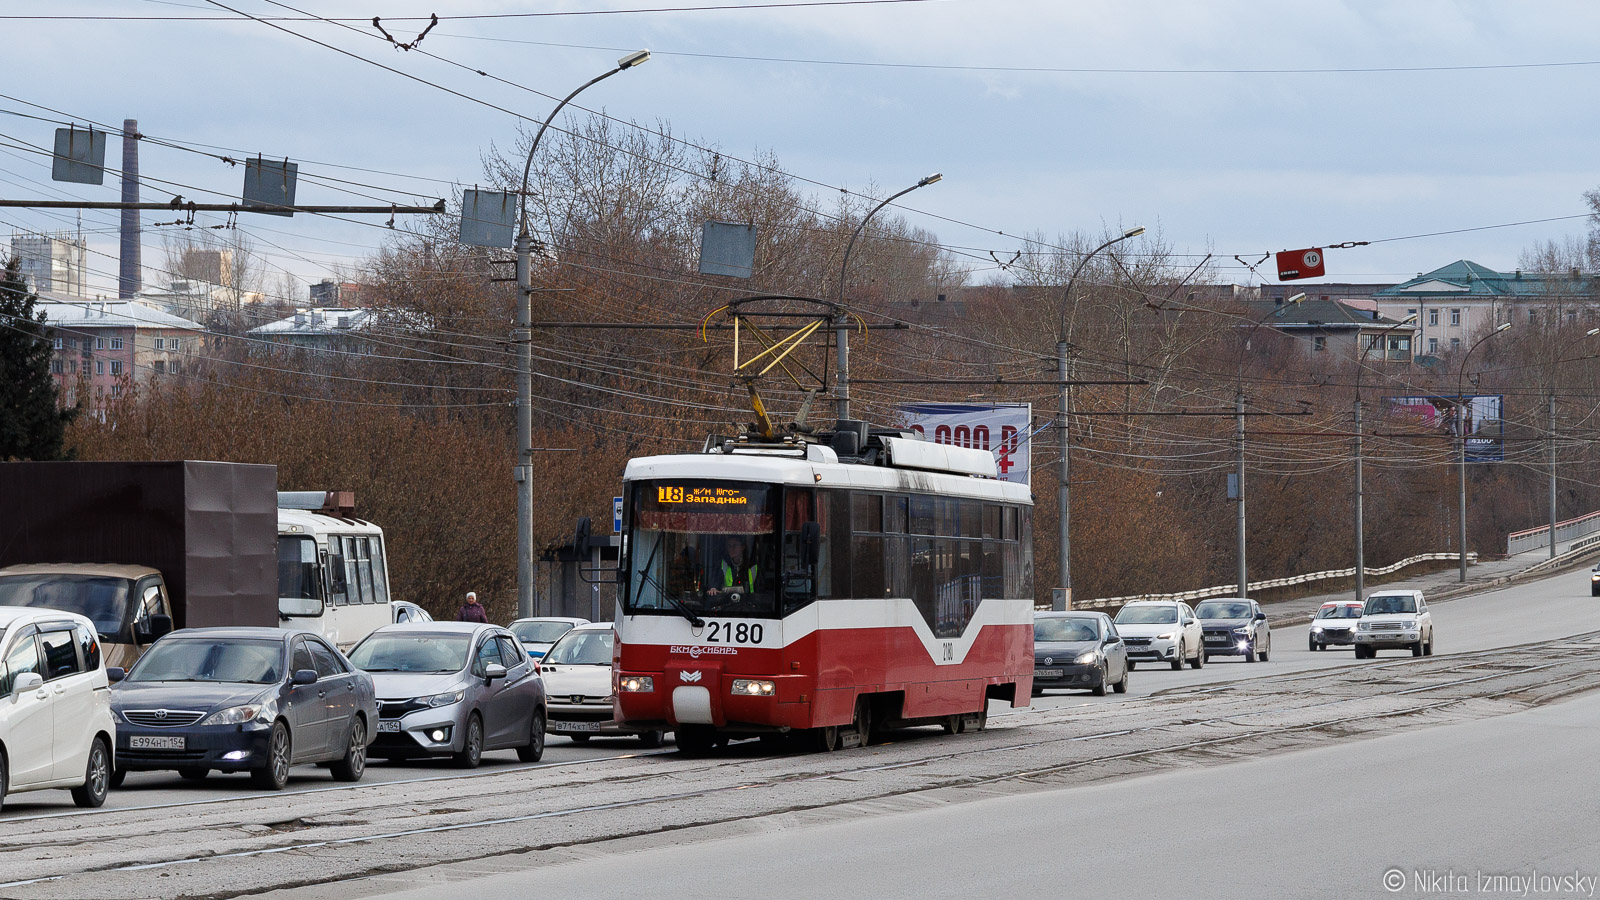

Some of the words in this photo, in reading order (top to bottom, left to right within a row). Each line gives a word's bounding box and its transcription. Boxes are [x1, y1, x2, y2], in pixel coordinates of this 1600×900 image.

[1306, 255, 1318, 263] 10
[658, 486, 684, 503] 18
[716, 488, 740, 496] Юго-
[686, 494, 747, 504] Западный
[706, 621, 763, 644] 2180
[942, 642, 954, 662] 2180
[169, 737, 184, 746] 154
